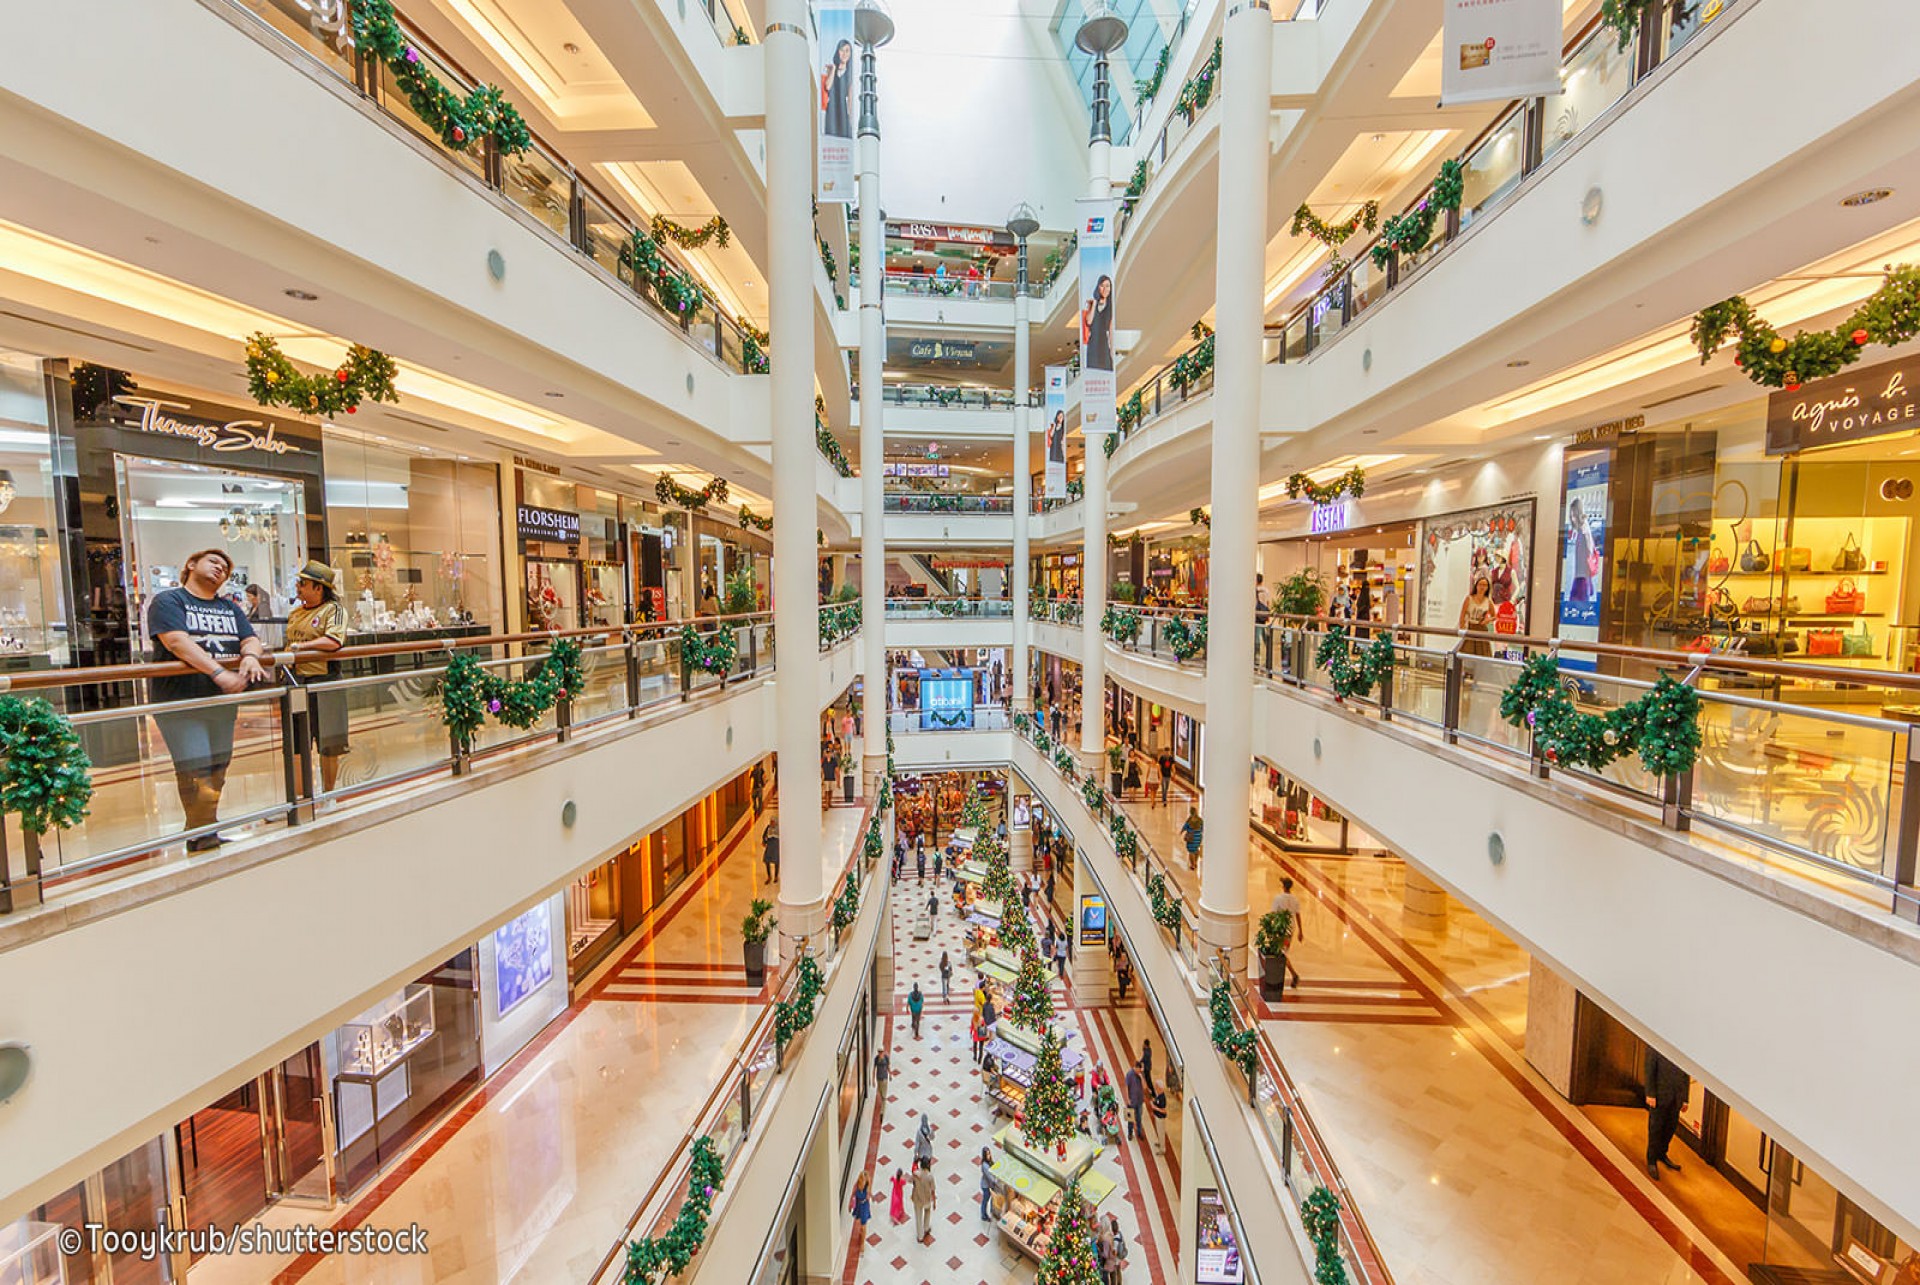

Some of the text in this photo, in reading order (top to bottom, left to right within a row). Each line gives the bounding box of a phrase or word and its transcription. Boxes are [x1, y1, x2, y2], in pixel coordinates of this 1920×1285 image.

[112, 395, 300, 454] Thomas Sabo
[1829, 403, 1915, 432] VOYAGE
[518, 507, 579, 530] FLORSHEIM
